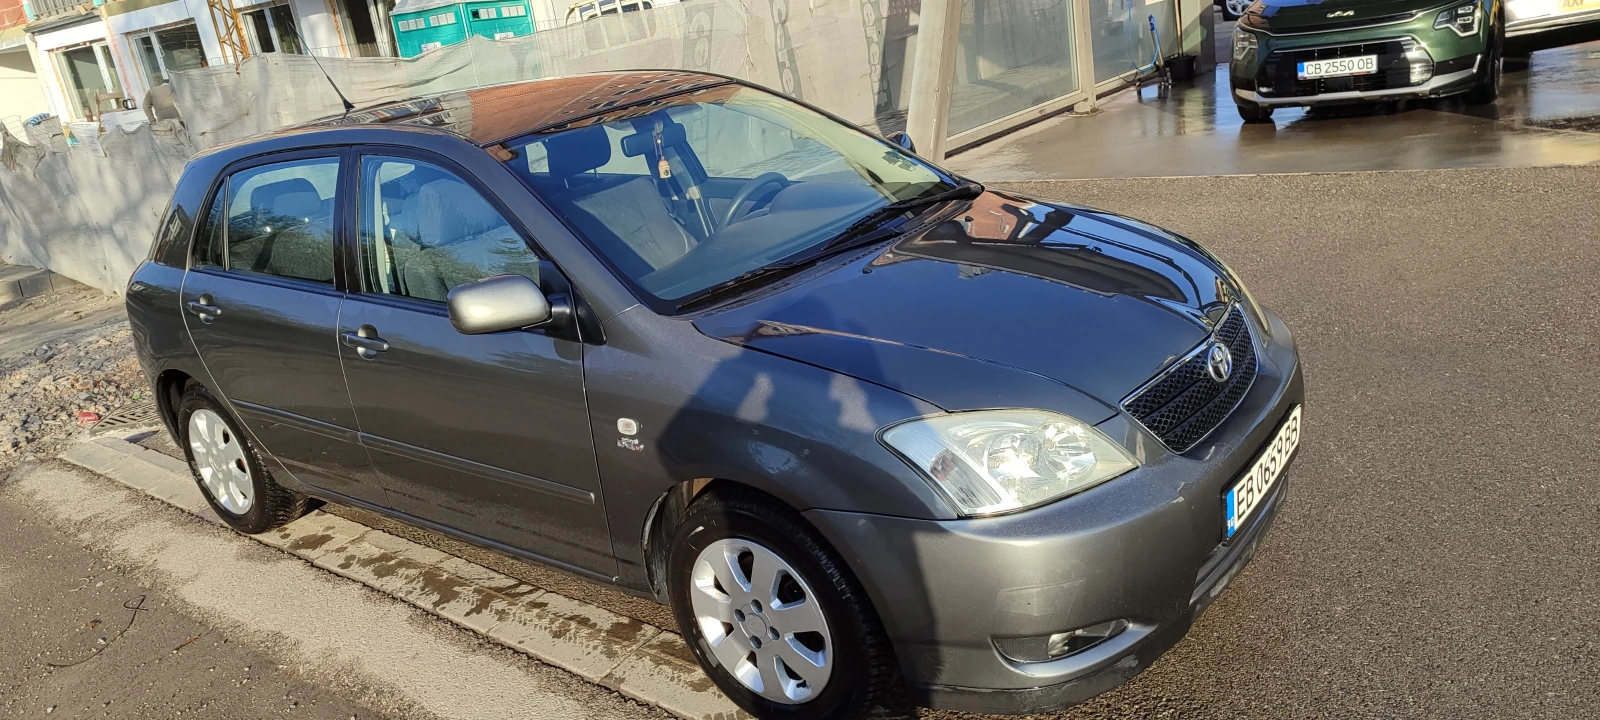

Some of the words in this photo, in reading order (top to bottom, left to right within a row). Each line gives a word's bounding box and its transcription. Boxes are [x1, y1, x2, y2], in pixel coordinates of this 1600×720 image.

[773, 0, 799, 98] Cere
[863, 0, 888, 106] eresit
[1306, 63, 1322, 75] CB
[1324, 60, 1355, 74] 2550
[1237, 475, 1255, 521] EB
[1257, 436, 1283, 495] 0659
[1285, 415, 1298, 458] BB
